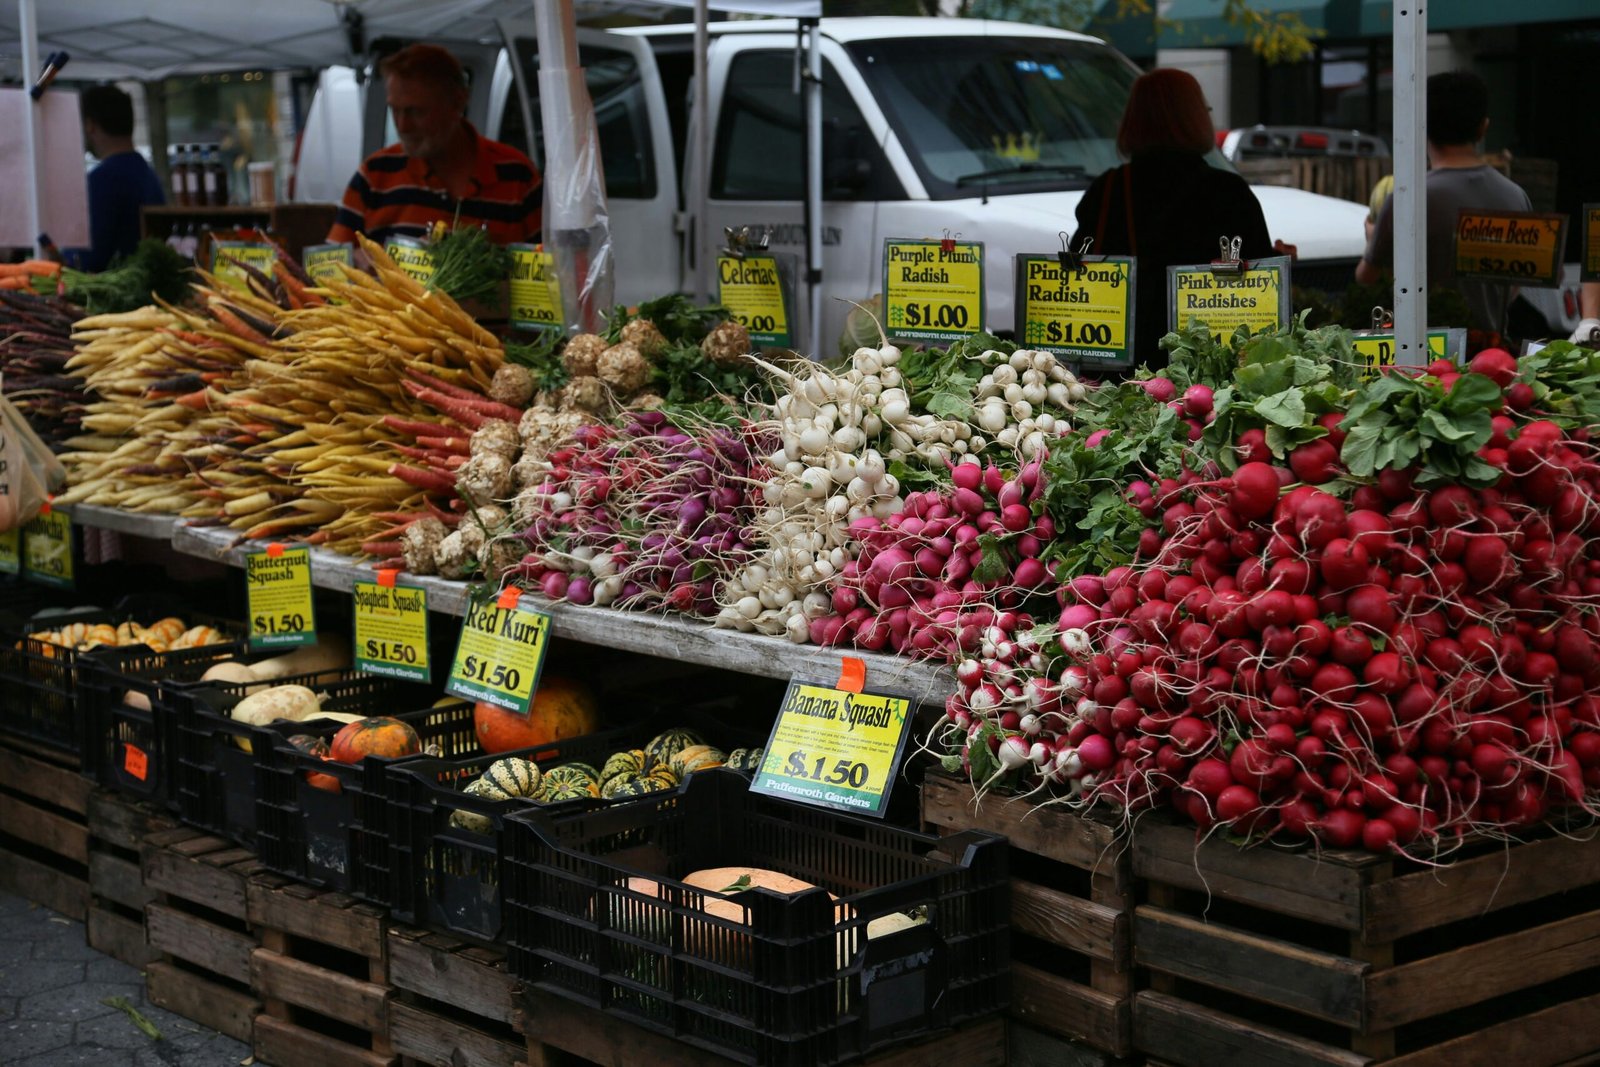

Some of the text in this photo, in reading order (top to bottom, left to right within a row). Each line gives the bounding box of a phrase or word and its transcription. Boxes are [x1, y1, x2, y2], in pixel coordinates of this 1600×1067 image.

[1460, 217, 1540, 245] Golden Beets
[388, 246, 434, 267] Rainb
[890, 246, 975, 266] Purple Plum
[1479, 257, 1537, 276] $2.00
[720, 259, 776, 285] Celeriac
[902, 267, 949, 284] Radish
[1029, 263, 1121, 288] Ping Pong
[1178, 274, 1270, 293] Pink Beauty
[1029, 285, 1090, 304] Radish
[1187, 293, 1257, 309] Radishes
[905, 303, 968, 328] $1.00
[1046, 320, 1112, 345] $1.00
[248, 553, 307, 570] Butternut
[248, 567, 294, 585] Squash
[354, 584, 421, 616] Spaghetti Squash
[255, 614, 304, 633] $1.50
[465, 600, 499, 634] Red
[500, 608, 542, 647] Kuri
[366, 640, 416, 663] $1.50
[462, 655, 520, 690] $1.50
[784, 685, 892, 732] Banana Squash
[765, 778, 871, 808] Paffenroth Gardens
